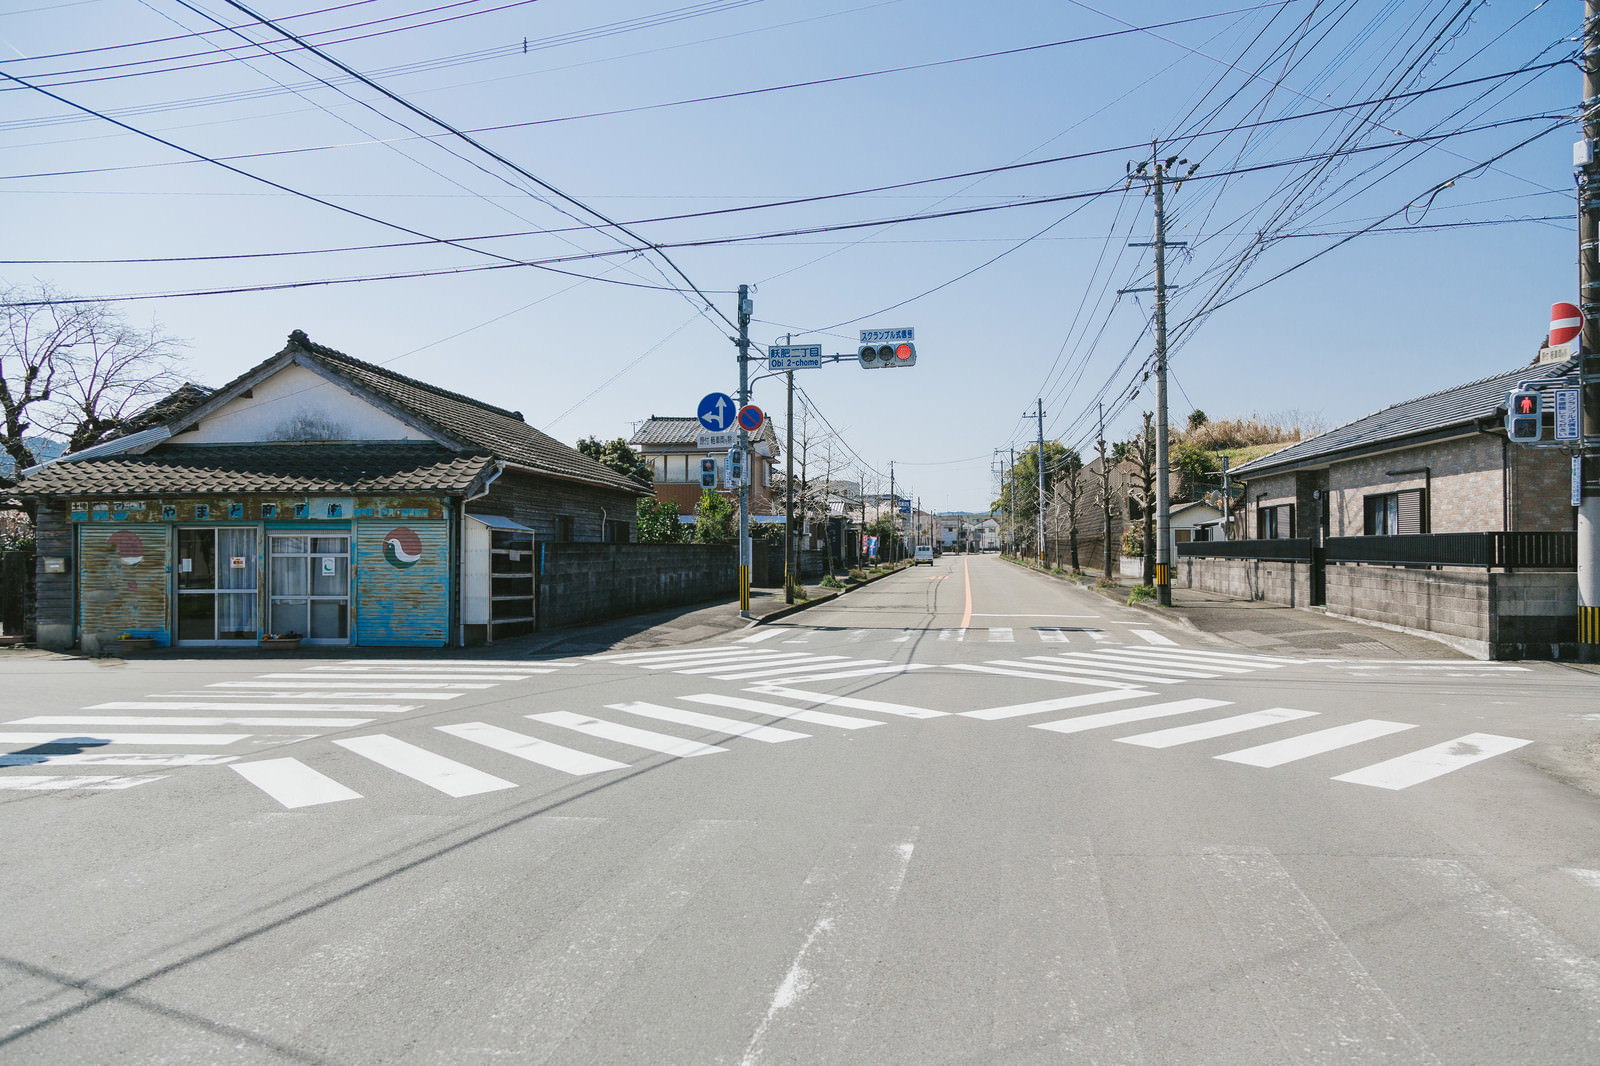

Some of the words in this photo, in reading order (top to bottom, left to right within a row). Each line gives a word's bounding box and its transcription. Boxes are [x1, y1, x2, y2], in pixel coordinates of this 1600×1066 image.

[861, 329, 912, 341] スクランブル式信号
[770, 347, 819, 358] 飫肥二丁目
[787, 359, 819, 367] 2-chome
